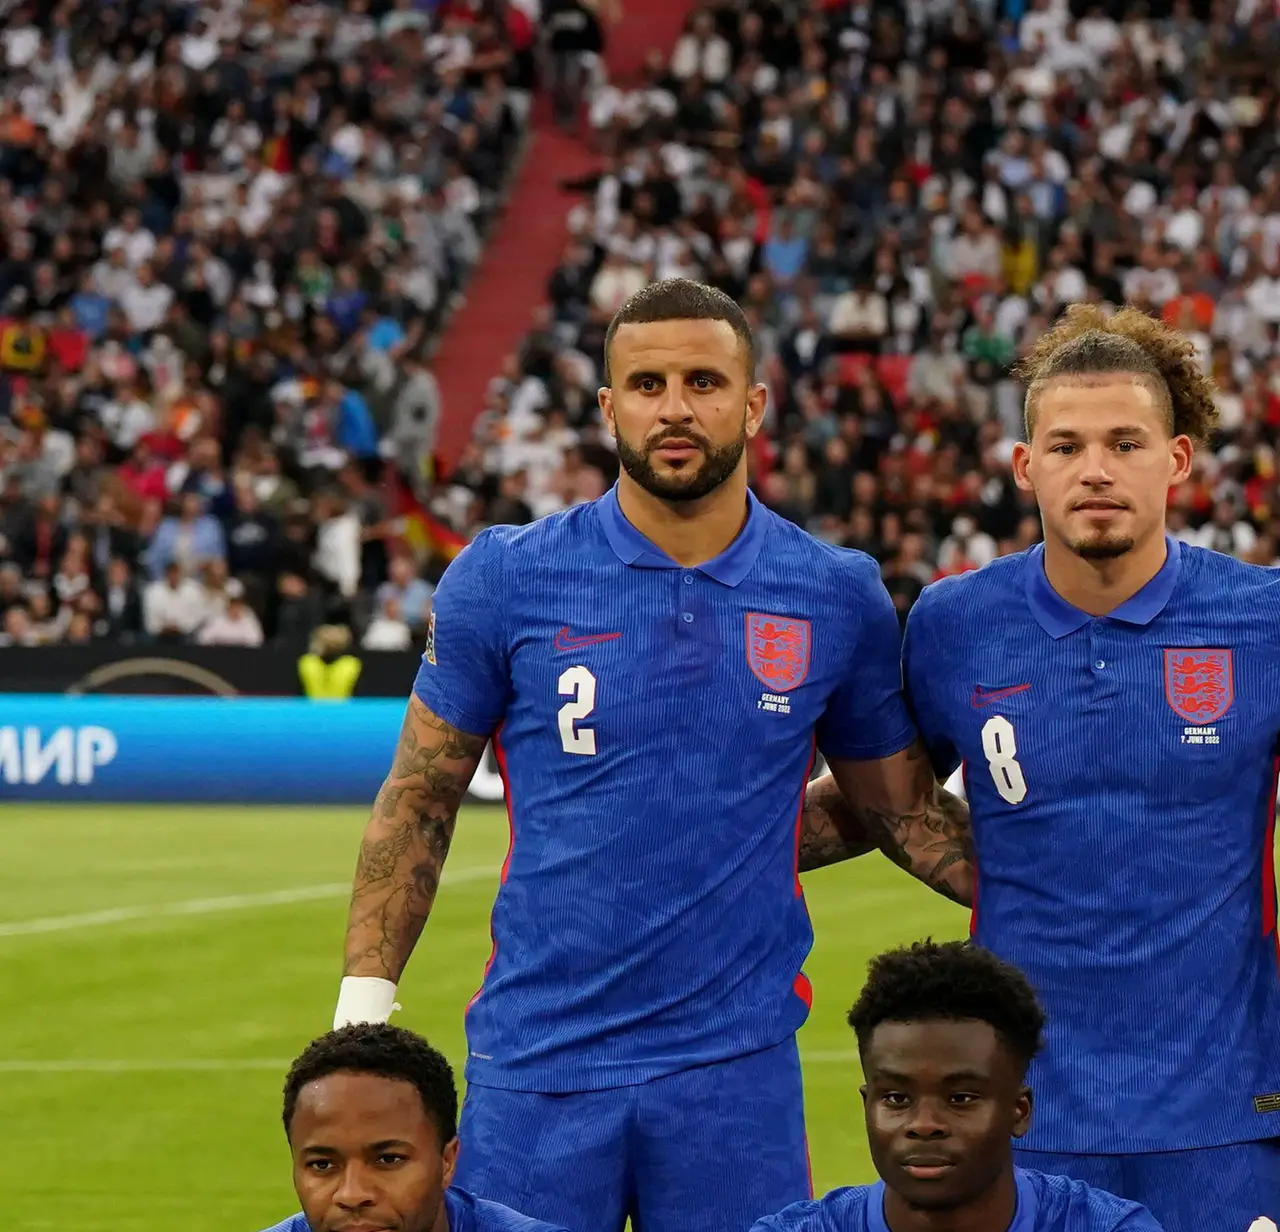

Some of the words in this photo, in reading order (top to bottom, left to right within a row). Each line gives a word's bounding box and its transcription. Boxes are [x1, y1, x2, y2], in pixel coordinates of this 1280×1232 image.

[761, 692, 789, 704] GERMANY
[557, 665, 597, 755] 2
[1184, 727, 1217, 735] GERMANY
[1186, 735, 1204, 744] JUNE
[981, 716, 1028, 804] 8
